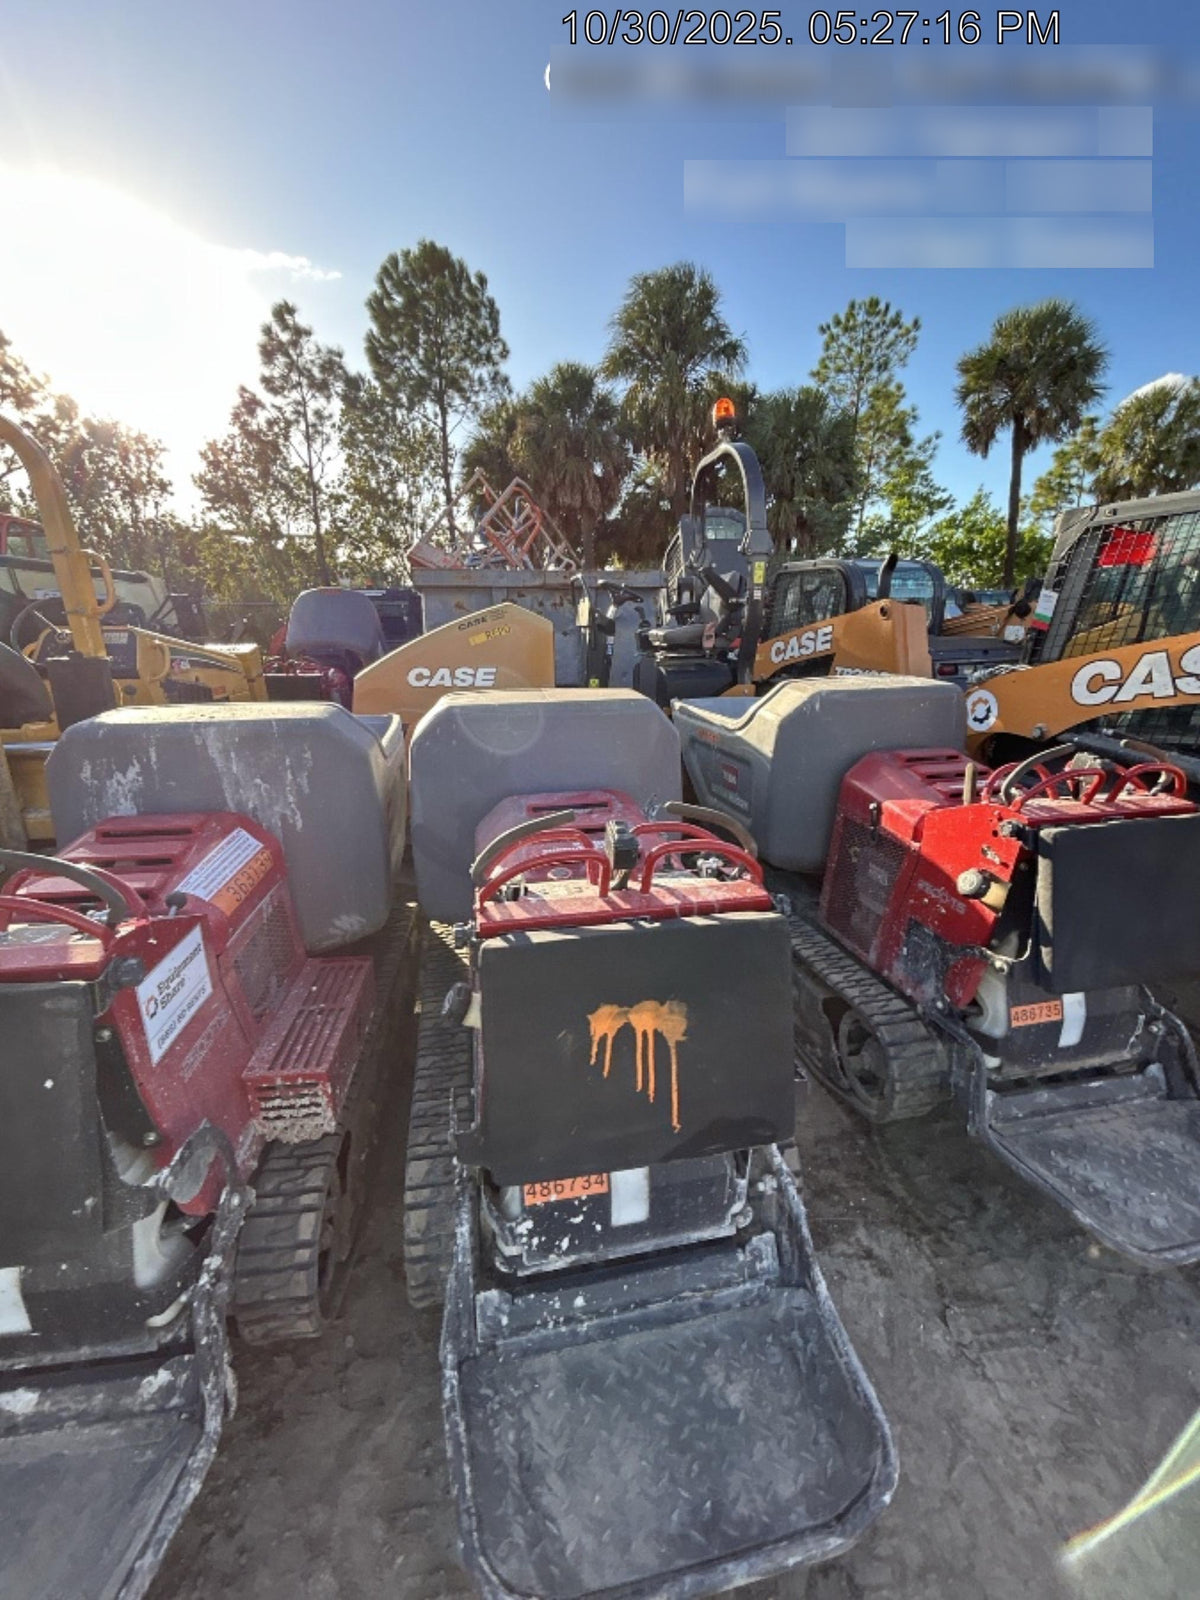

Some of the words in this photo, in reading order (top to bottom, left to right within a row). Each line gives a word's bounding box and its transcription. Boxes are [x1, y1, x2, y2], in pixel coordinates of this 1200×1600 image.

[771, 624, 834, 664] CASE
[406, 666, 497, 688] CASE
[160, 977, 185, 1010] Share
[525, 1174, 606, 1199] 486734
